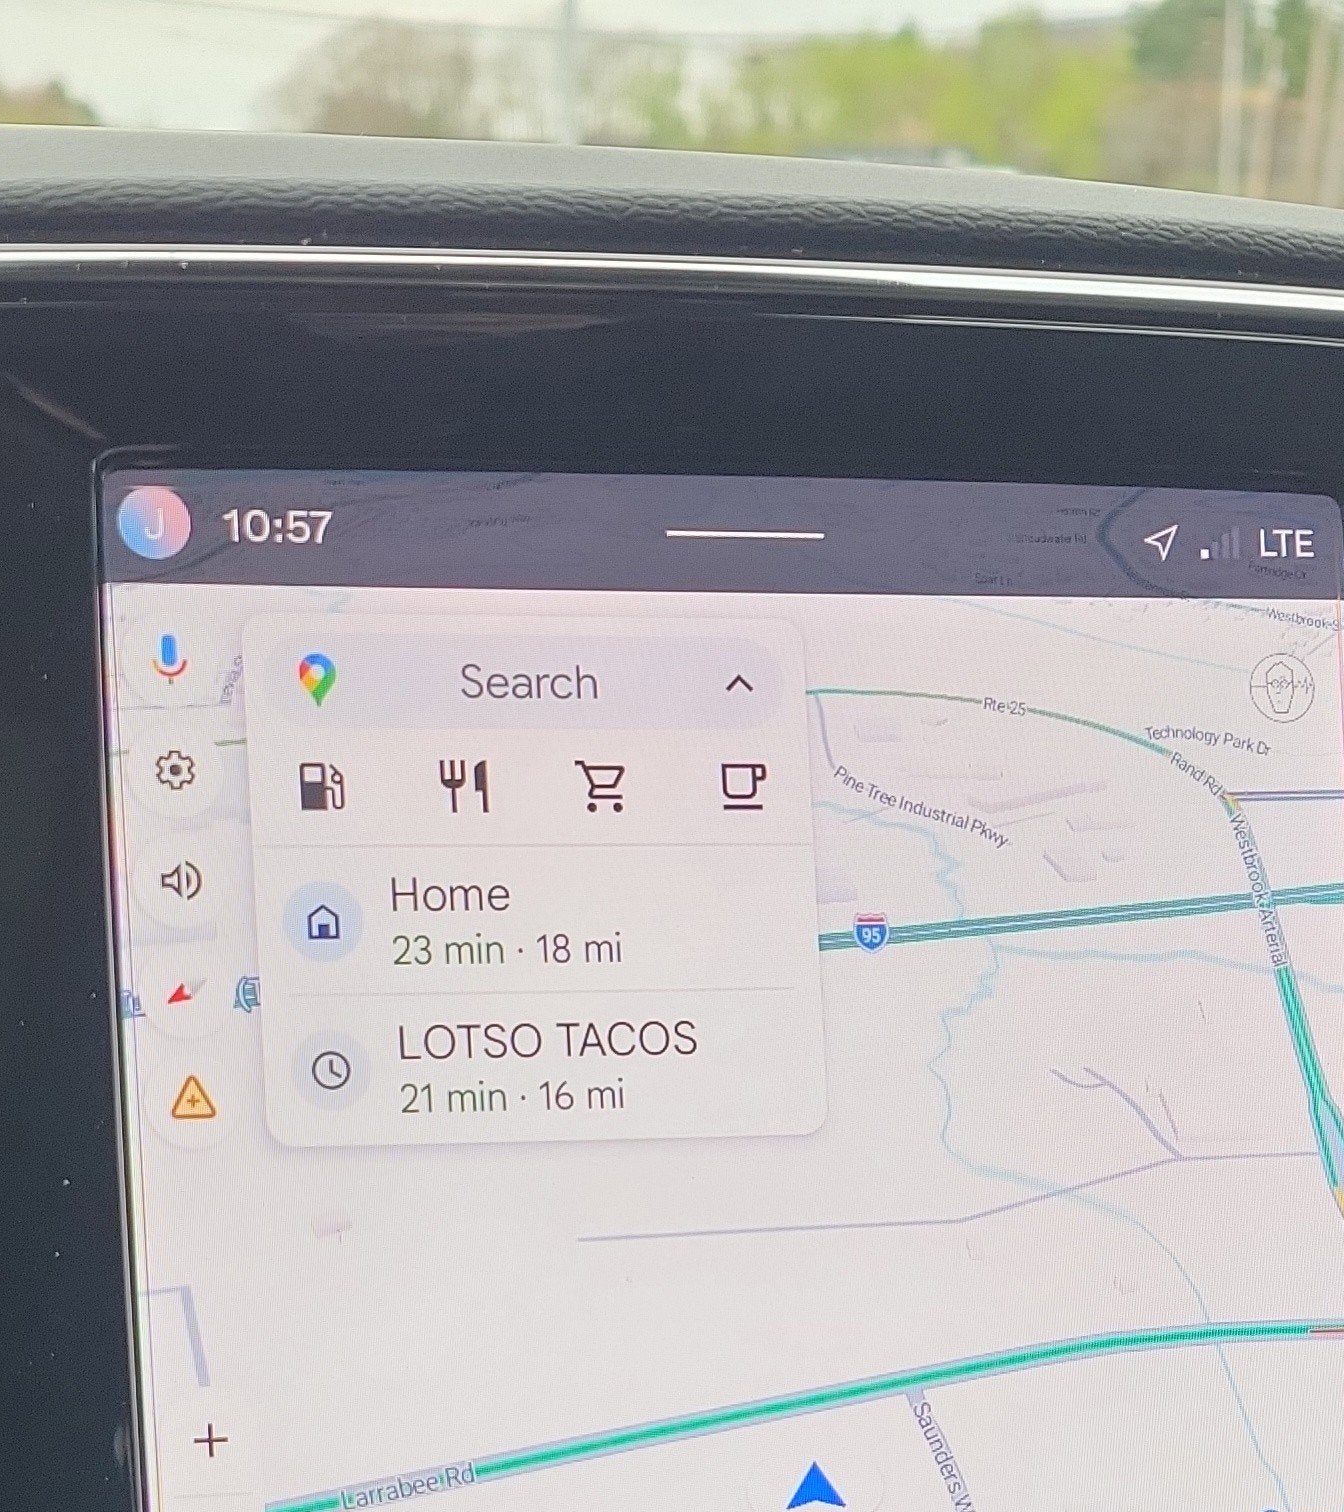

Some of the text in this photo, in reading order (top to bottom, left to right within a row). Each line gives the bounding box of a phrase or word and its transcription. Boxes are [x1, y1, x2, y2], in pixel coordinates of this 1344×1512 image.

[222, 508, 333, 545] 10:57
[1259, 528, 1315, 558] LTE
[460, 662, 600, 701] Search
[983, 696, 1027, 716] Rte 25
[1145, 724, 1272, 757] Technology Park Dr
[1169, 750, 1225, 798] Rand Rd
[833, 764, 1010, 850] Pine Tree Industrial Pkwy
[389, 875, 512, 913] Home
[1229, 812, 1289, 968] Westbrook Arterial
[391, 930, 623, 967] 23 min 18 mi
[861, 926, 882, 943] 95
[397, 1019, 699, 1061] LOTSO TACOS
[400, 1077, 625, 1115] 21 min 16 mi
[912, 1399, 963, 1497] Saunders
[340, 1461, 476, 1512] Larrabee Rd
